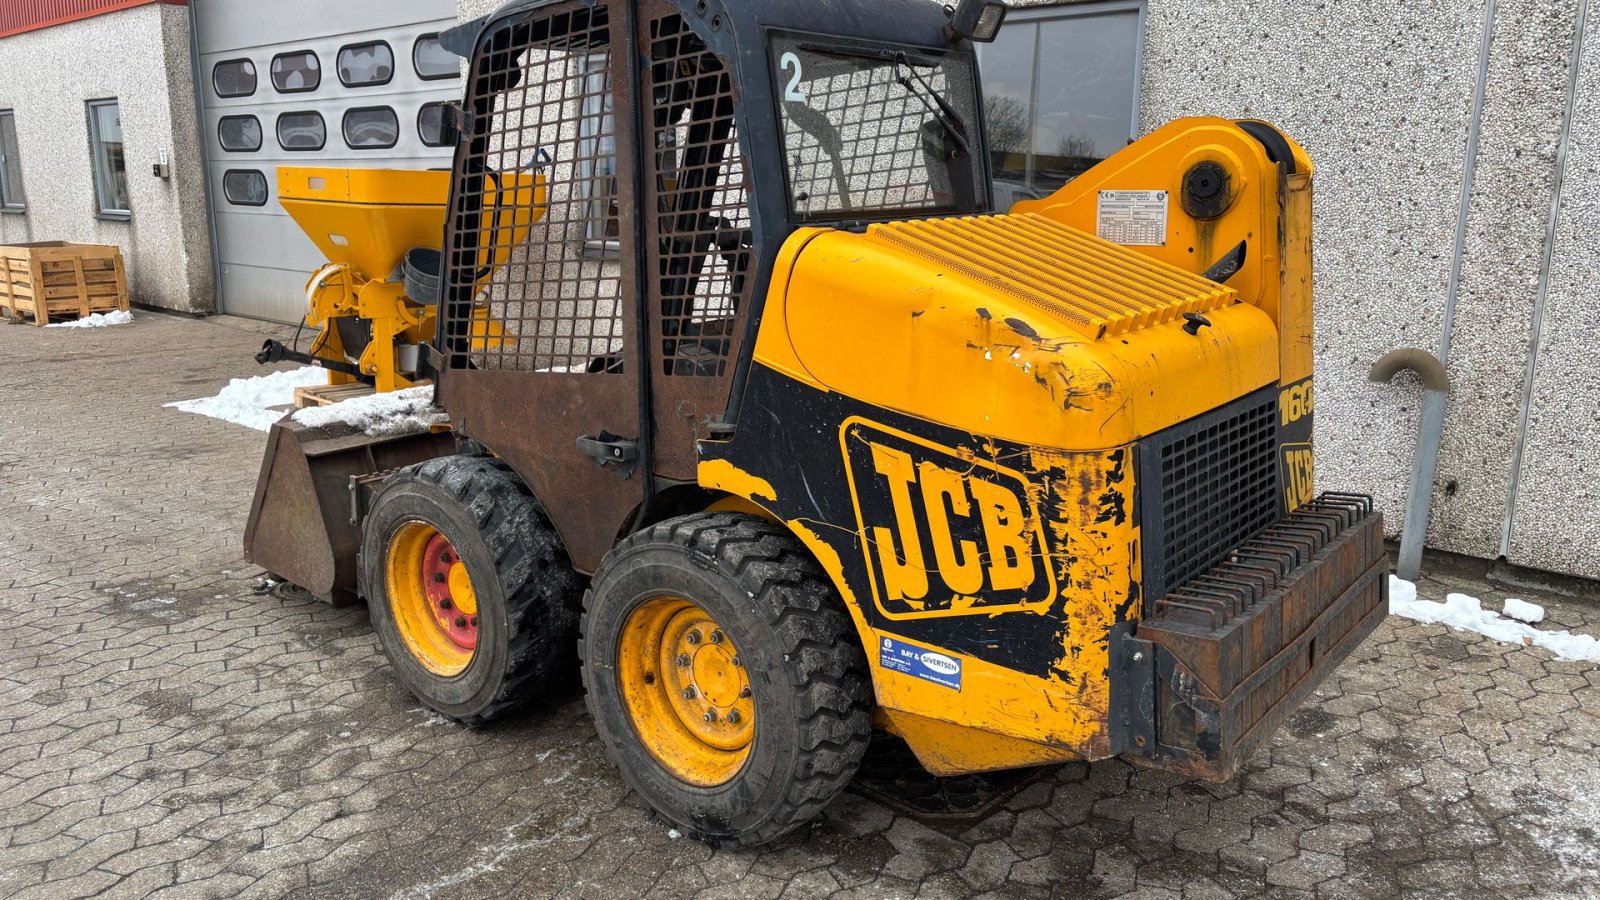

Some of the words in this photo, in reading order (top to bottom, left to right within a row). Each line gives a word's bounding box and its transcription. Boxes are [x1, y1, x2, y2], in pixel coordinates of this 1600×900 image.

[781, 51, 806, 102] 2
[1279, 380, 1314, 427] 160
[1285, 449, 1314, 513] JCB
[870, 441, 1036, 601] JCB
[901, 649, 914, 659] BAY
[914, 653, 920, 661] &
[922, 655, 957, 672] SIVERTSEN
